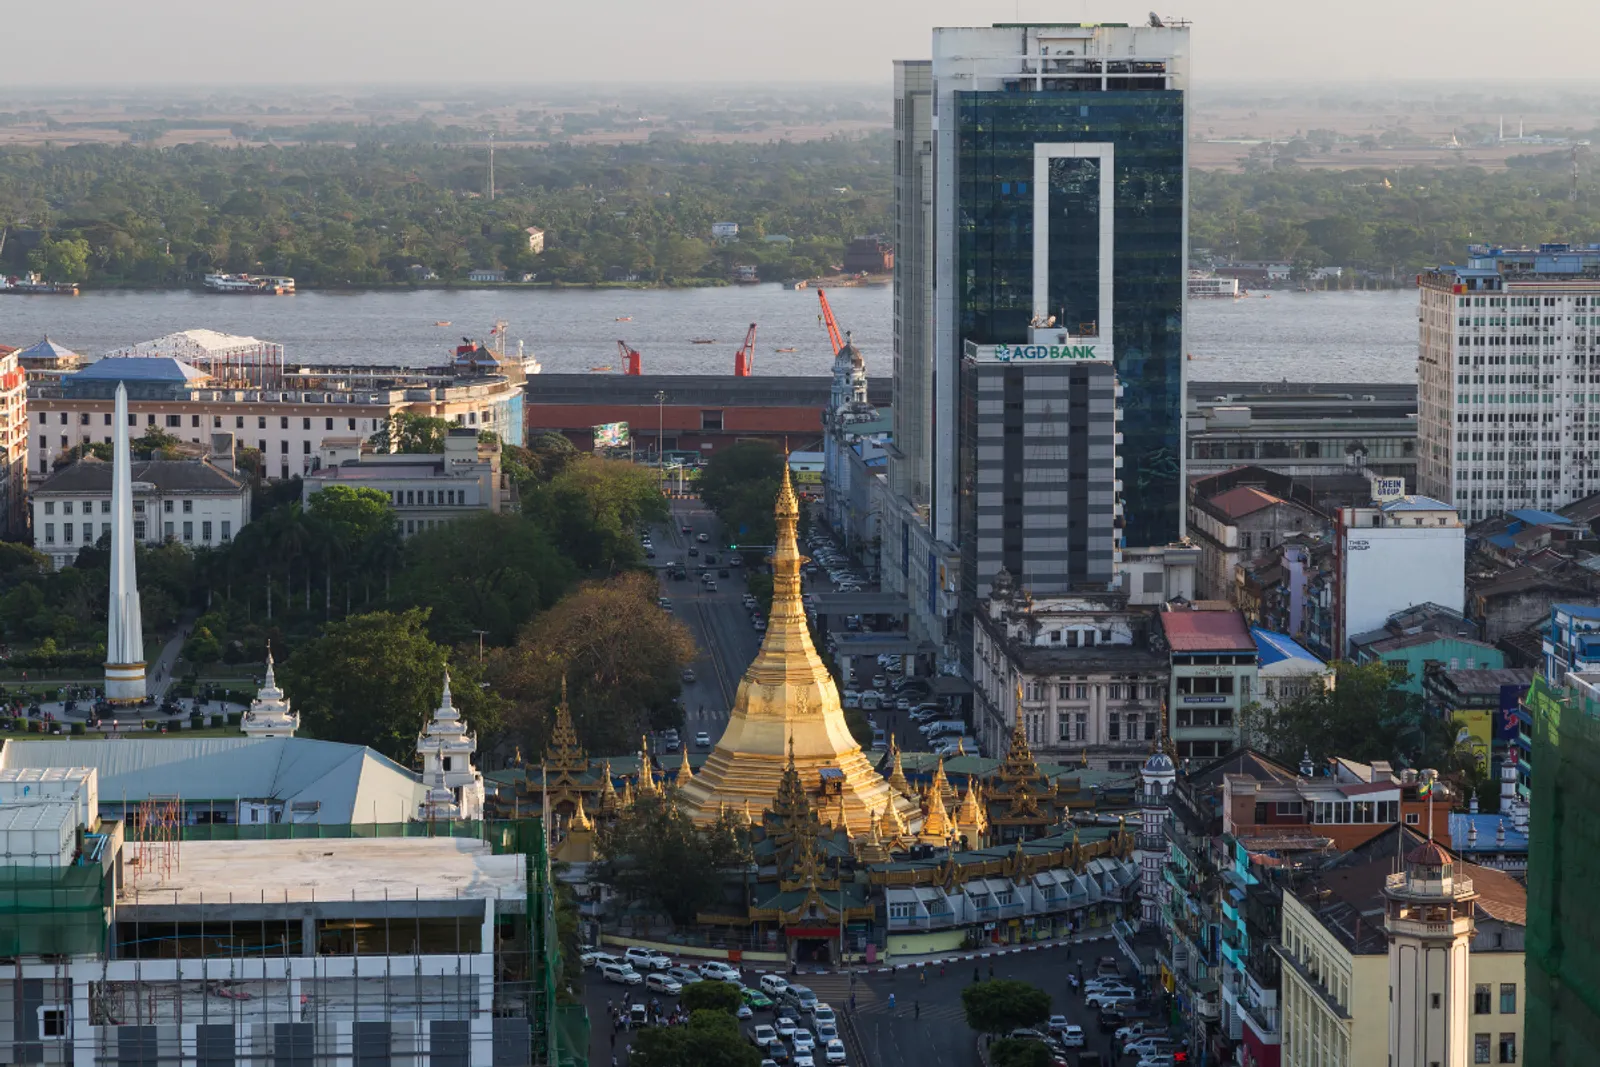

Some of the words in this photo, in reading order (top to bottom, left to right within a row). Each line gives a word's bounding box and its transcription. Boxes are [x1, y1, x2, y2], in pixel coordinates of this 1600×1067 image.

[1012, 345, 1048, 359] AGD
[1050, 345, 1096, 359] BANK
[1377, 480, 1401, 488] THEIN
